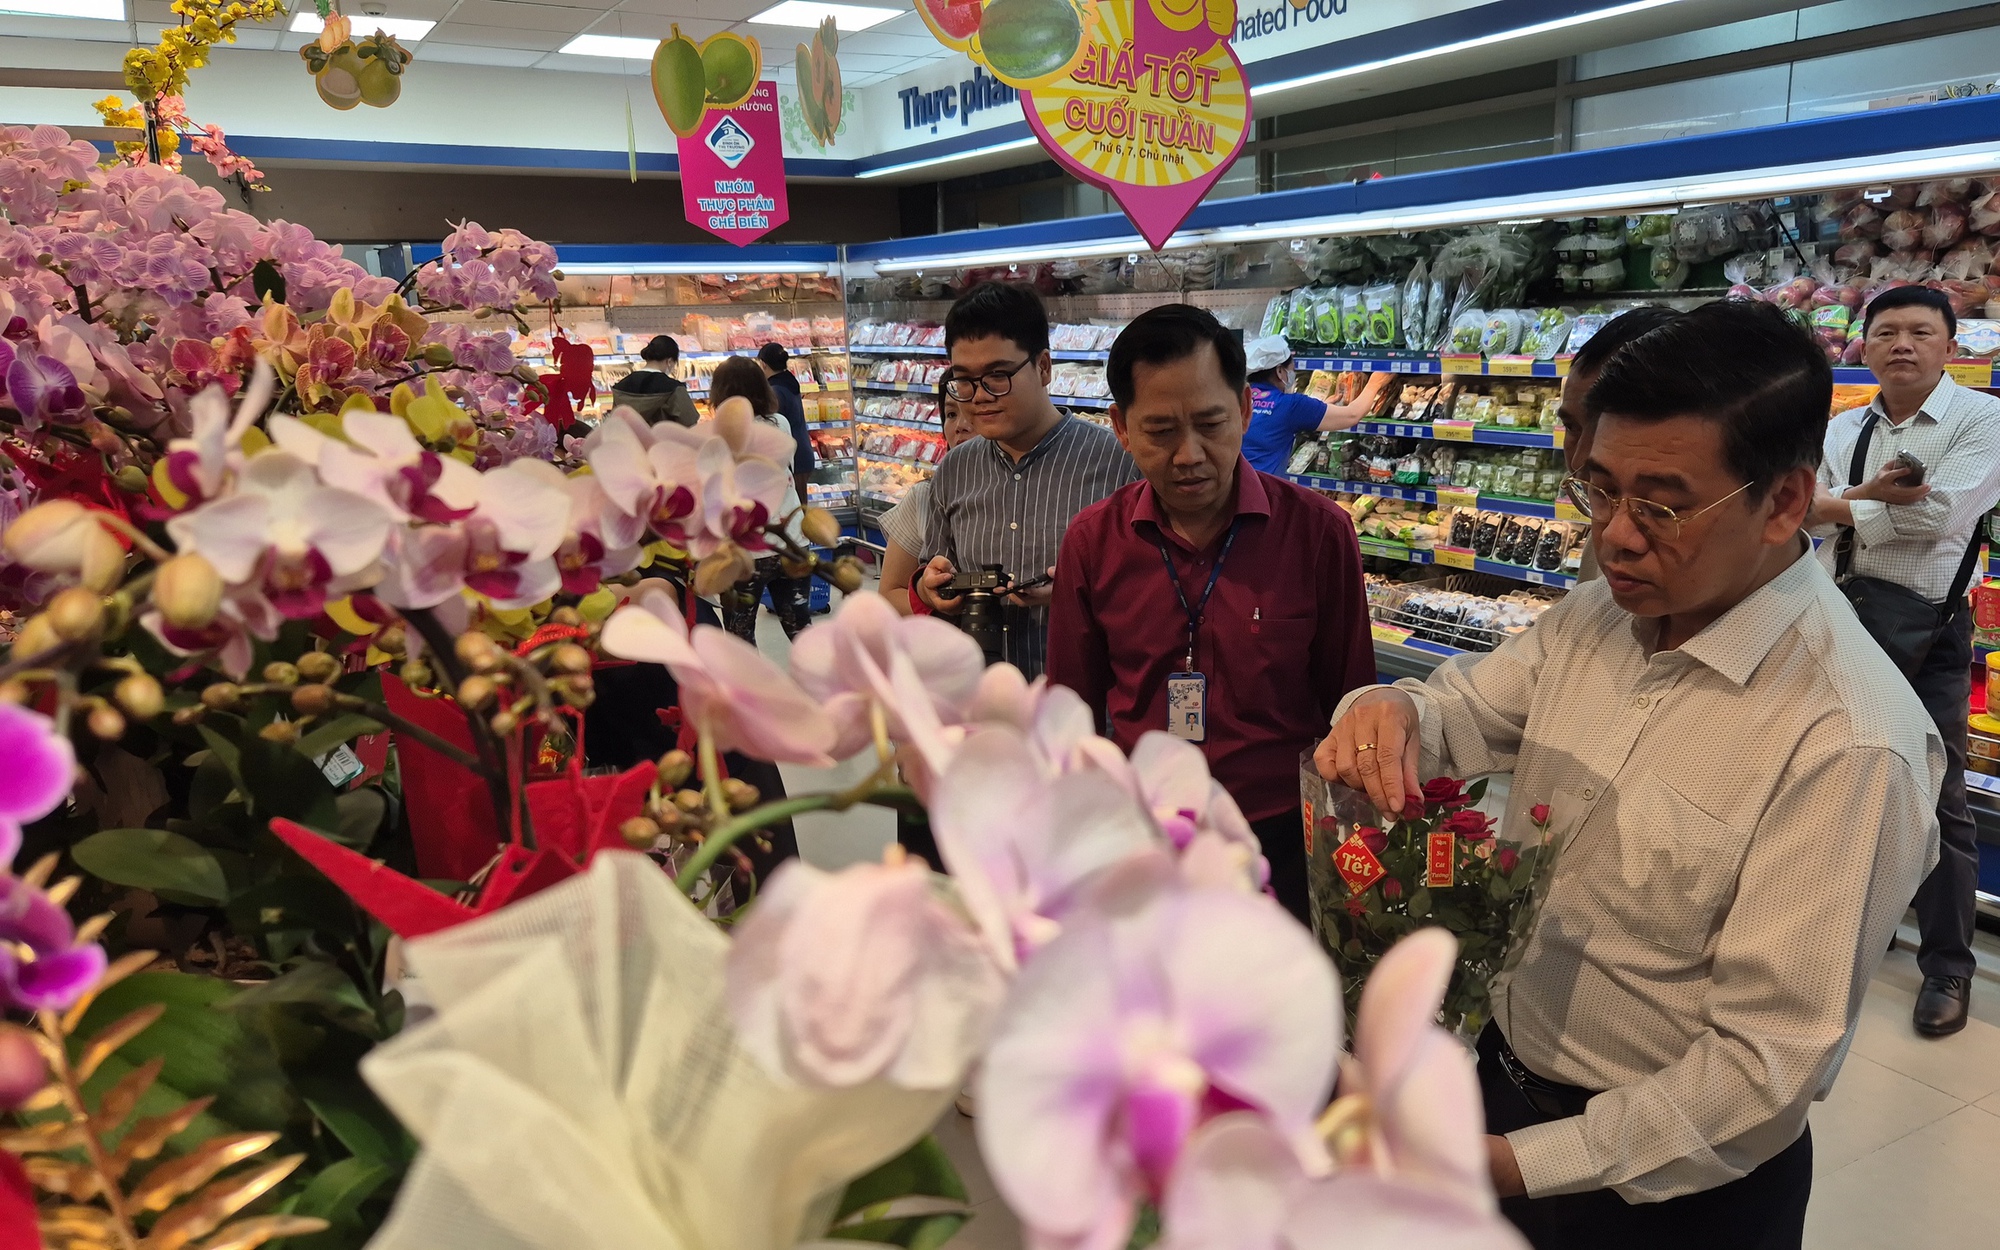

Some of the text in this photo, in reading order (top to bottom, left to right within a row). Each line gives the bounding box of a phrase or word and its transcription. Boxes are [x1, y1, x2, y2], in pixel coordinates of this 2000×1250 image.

[1231, 0, 1287, 44] nated
[1070, 39, 1220, 106] GIÁ TỐT
[898, 85, 957, 134] Thực
[1063, 96, 1216, 155] CUỐI TUẦN
[1093, 140, 1185, 166] Thứ 6, 7, Chủ nhật
[715, 178, 755, 194] NHÓM
[697, 194, 775, 214] THỰC PHẨM
[709, 212, 769, 229] CHẾ BIẾN
[1342, 852, 1373, 877] Tết
